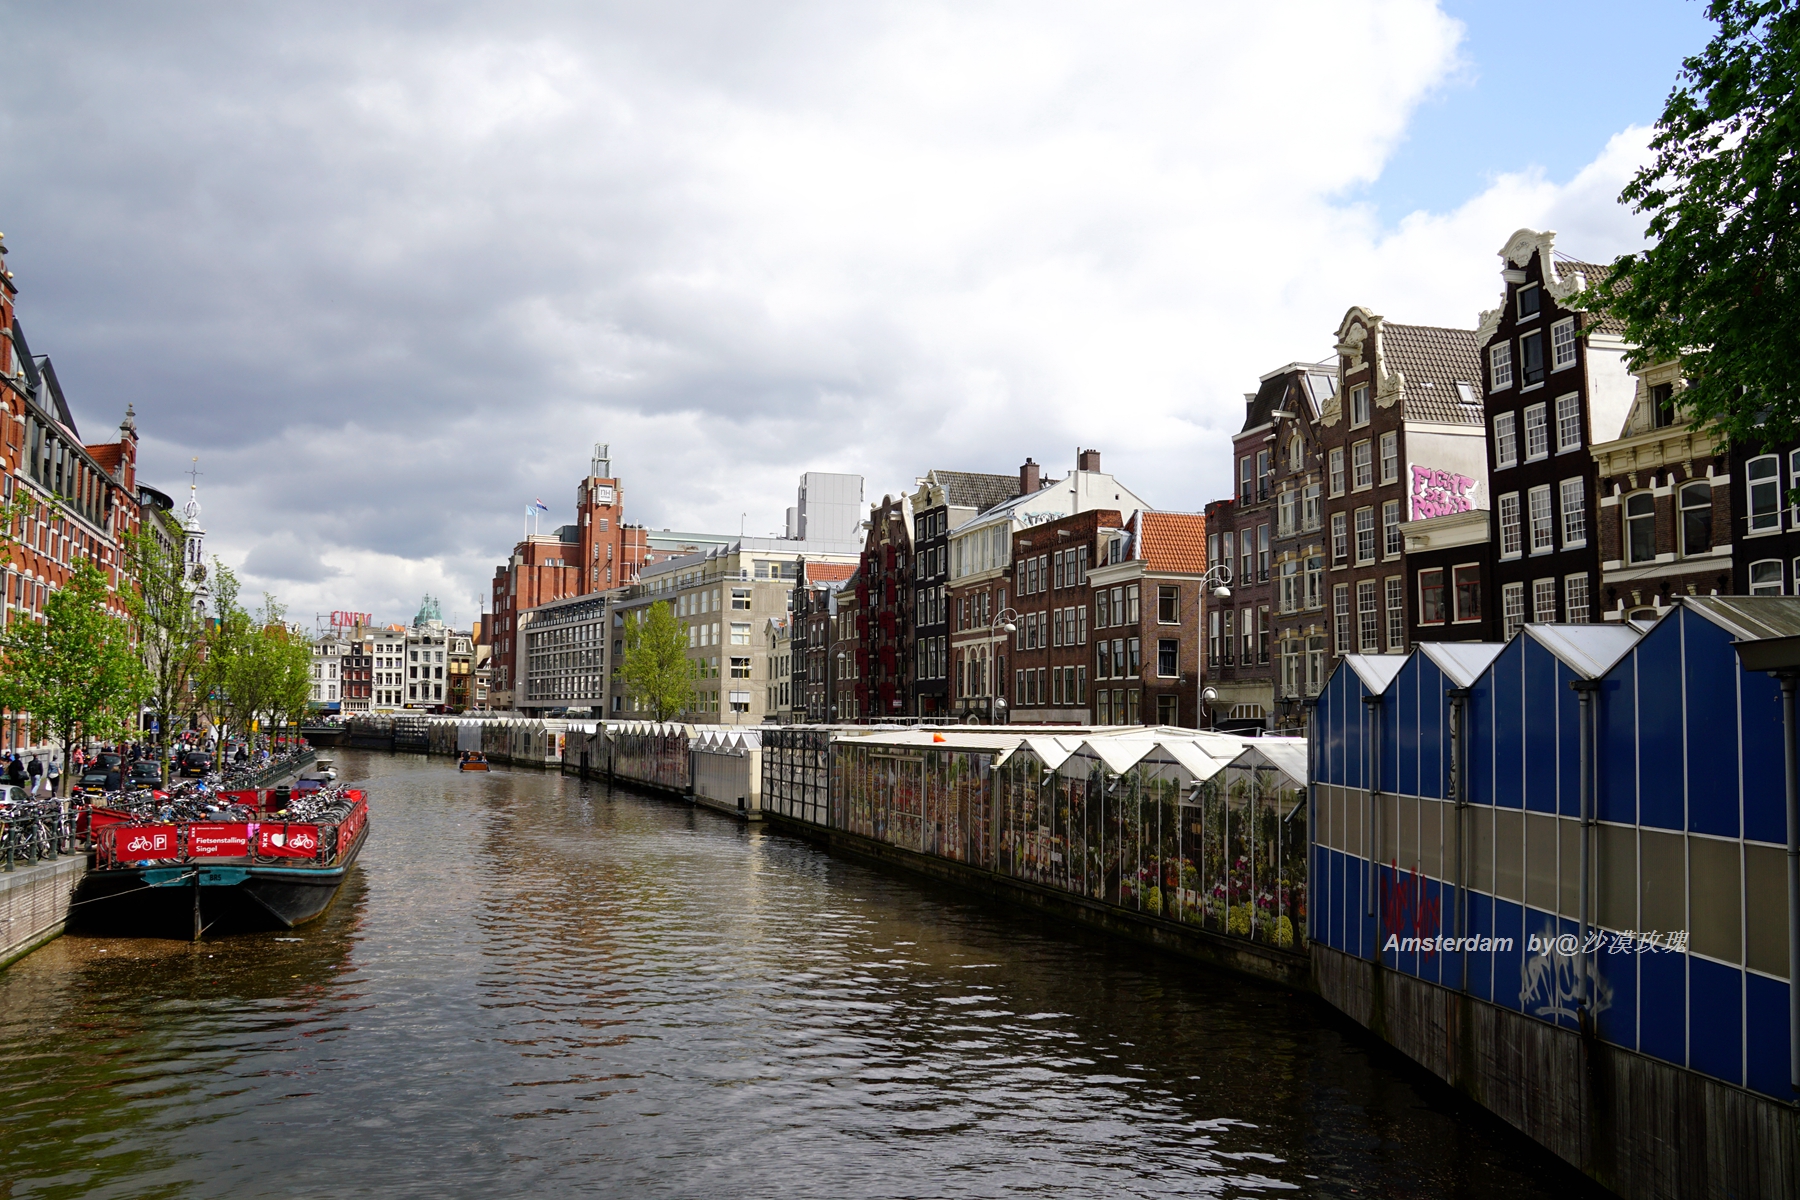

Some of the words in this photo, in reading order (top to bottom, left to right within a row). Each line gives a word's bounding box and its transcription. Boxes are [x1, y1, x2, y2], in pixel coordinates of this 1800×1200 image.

[1411, 465, 1475, 495] FIGHT
[196, 837, 246, 845] Fietsenstalling
[196, 845, 218, 853] Singel
